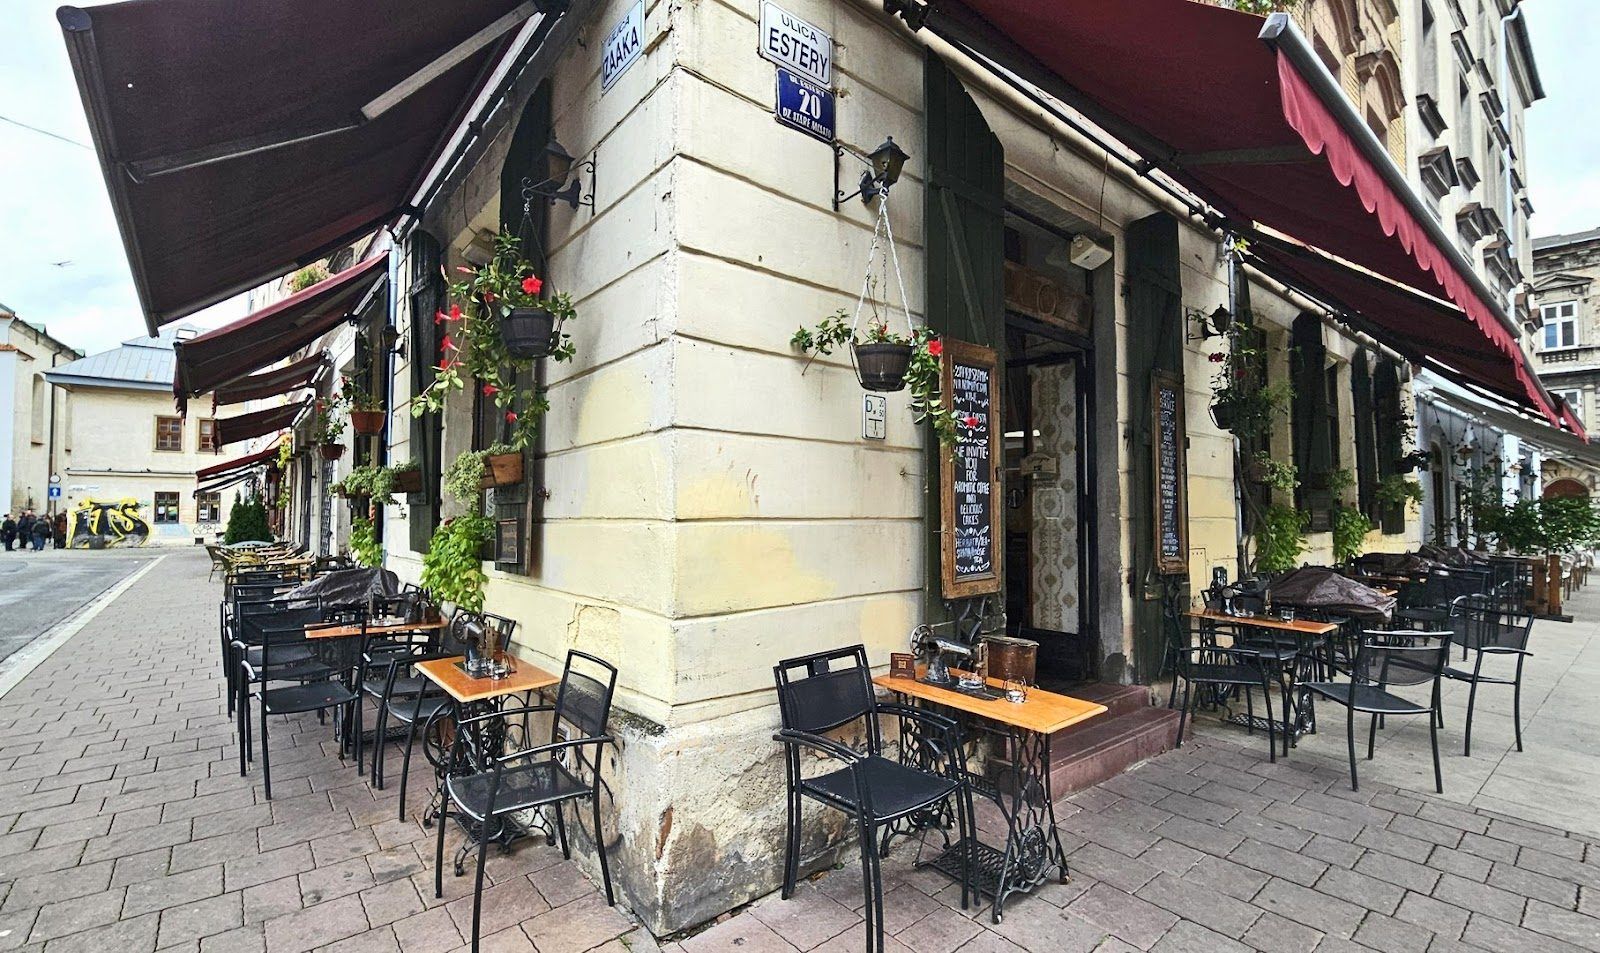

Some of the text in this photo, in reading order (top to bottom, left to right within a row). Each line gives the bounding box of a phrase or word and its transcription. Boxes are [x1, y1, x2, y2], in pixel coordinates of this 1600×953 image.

[781, 14, 818, 45] ULICA
[769, 27, 828, 78] ESTERY
[798, 88, 822, 120] 20
[965, 457, 978, 470] YOU
[966, 446, 987, 459] INVITE
[965, 470, 978, 482] FOR
